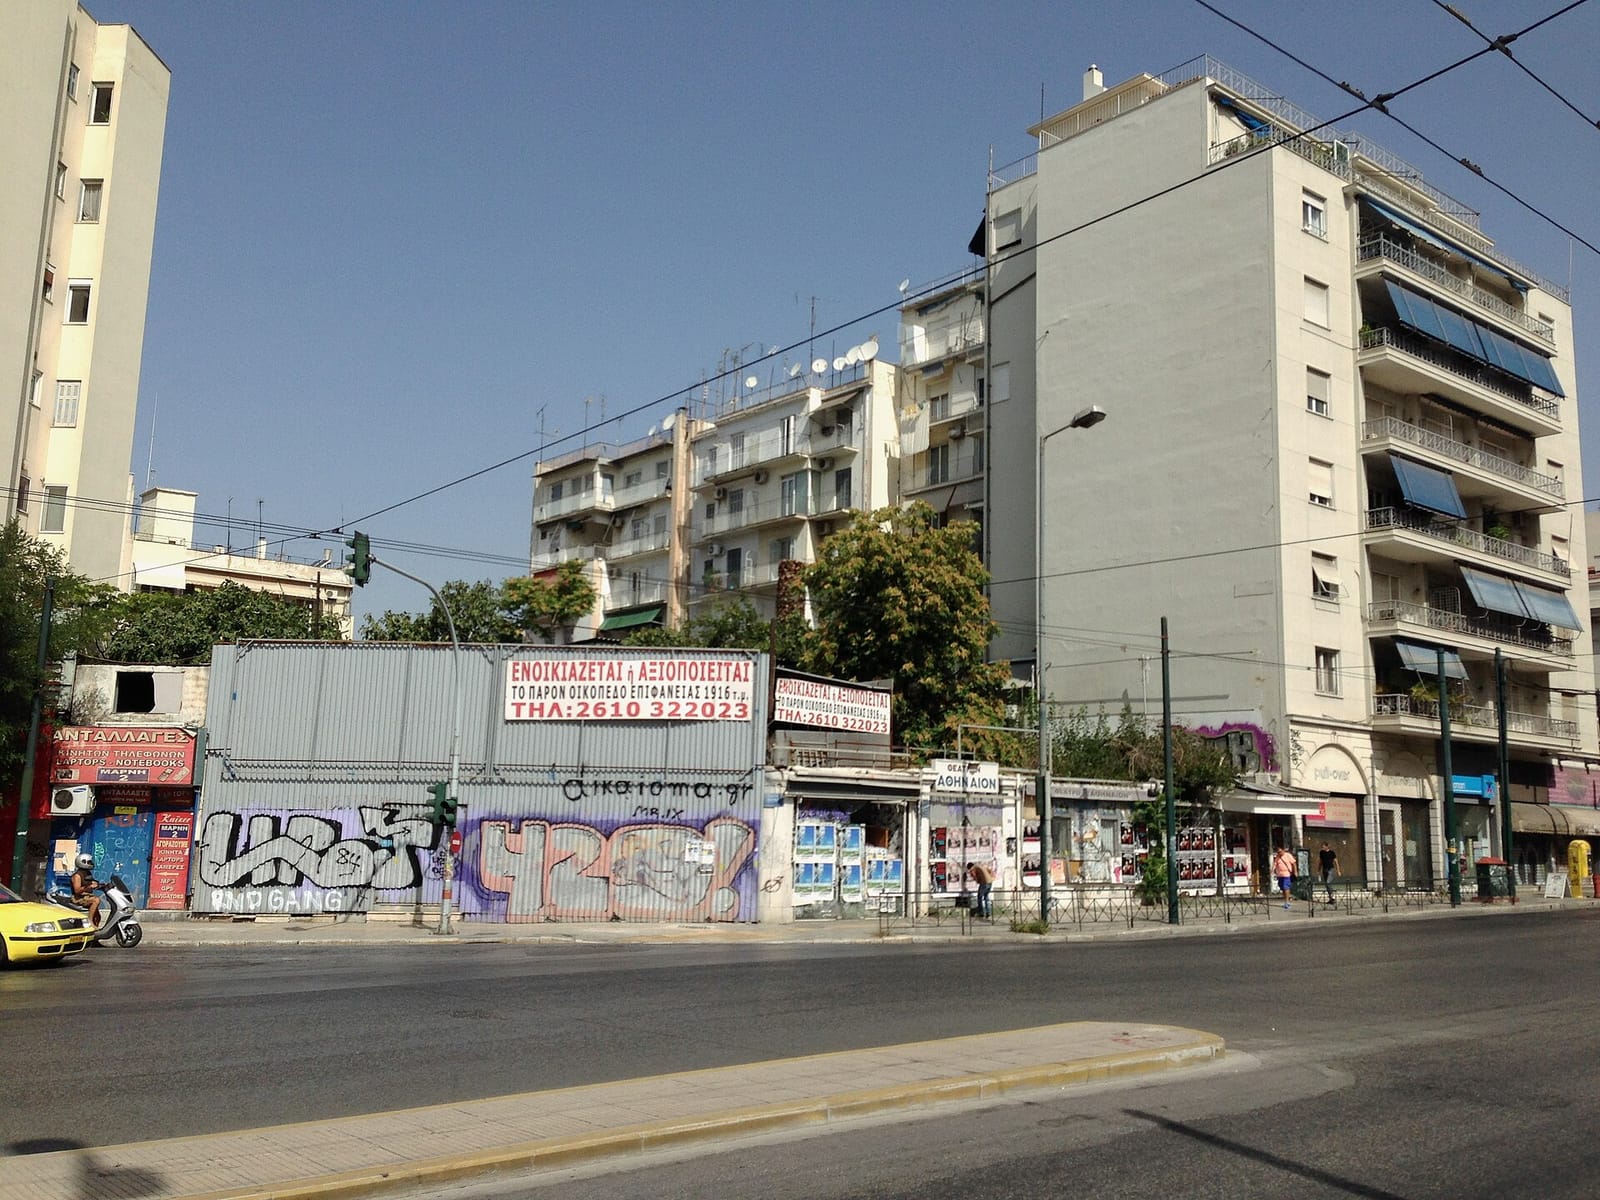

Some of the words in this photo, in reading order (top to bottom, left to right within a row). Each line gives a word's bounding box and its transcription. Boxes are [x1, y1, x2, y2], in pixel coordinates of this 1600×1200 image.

[511, 661, 623, 682] ΕΝΟΙΚΙΑΖΕΤΑΙ
[638, 661, 750, 682] ΑΞΙΟΠΟΙΕΙΤΑΙ
[511, 685, 525, 700] ΤΟ
[528, 685, 565, 700] ΠΑΡΟΝ
[569, 685, 627, 700] ΟΙΚΟΠΕΔΟ
[630, 685, 700, 700] ΕΠΙΦΑΝΕΙΑΣ
[704, 685, 730, 700] 1916
[777, 680, 831, 700] ΕΝΟΙΚΙΑΖΕΤΑΙ
[837, 688, 888, 708] ΑΞΙΟΠΟΙΕΙΤΑΙ
[511, 701, 640, 718] ΤΗΛ:2610
[650, 701, 749, 718] 322023
[778, 709, 839, 726] ΤΗΛ:2610
[842, 717, 888, 733] 322023
[53, 730, 190, 743] ΑΝΤΑΛΛΑΓΕΣ
[59, 750, 109, 758] ΚΙΝΗΤΩΝ
[113, 750, 185, 758] ΤΗΛΕΦΩΝΩΝ
[116, 759, 185, 767] NOTEBOOKS
[119, 774, 129, 782] 2
[172, 830, 178, 838] 2
[268, 890, 343, 912] GANG
